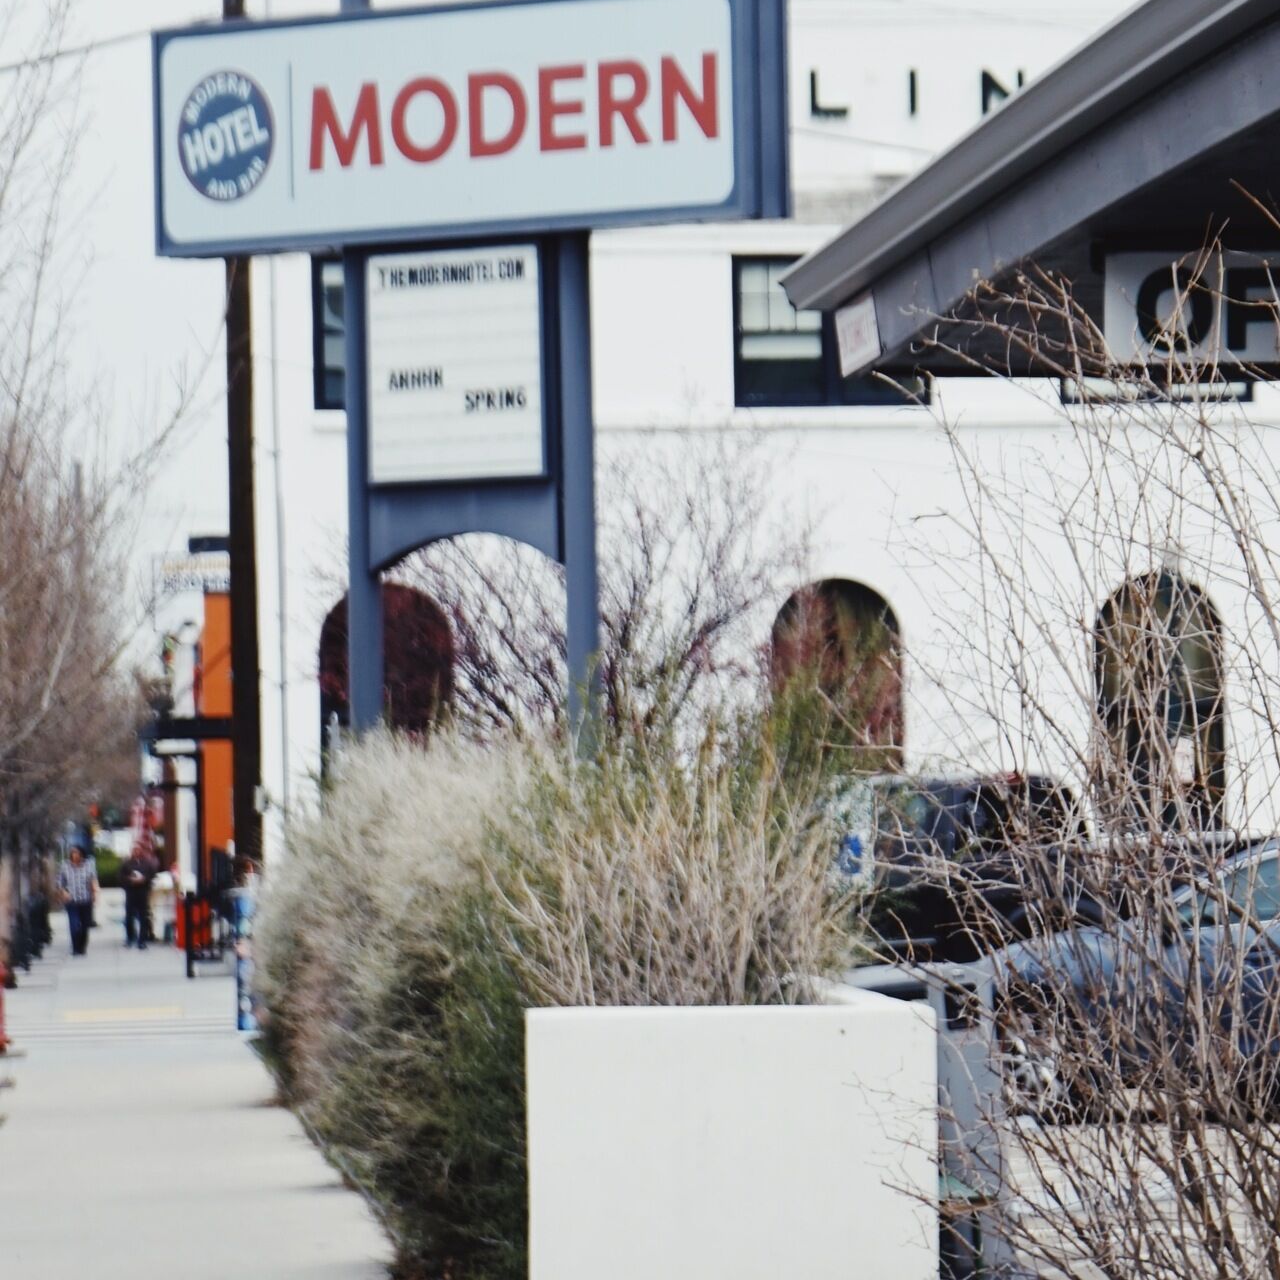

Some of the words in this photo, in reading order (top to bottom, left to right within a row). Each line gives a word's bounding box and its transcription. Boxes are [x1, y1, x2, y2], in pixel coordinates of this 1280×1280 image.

[185, 72, 252, 126] MODERN
[308, 51, 720, 172] MODERN
[182, 103, 270, 176] HOTEL
[206, 178, 238, 200] AND
[238, 155, 266, 194] BAR
[464, 387, 527, 414] SPRING
